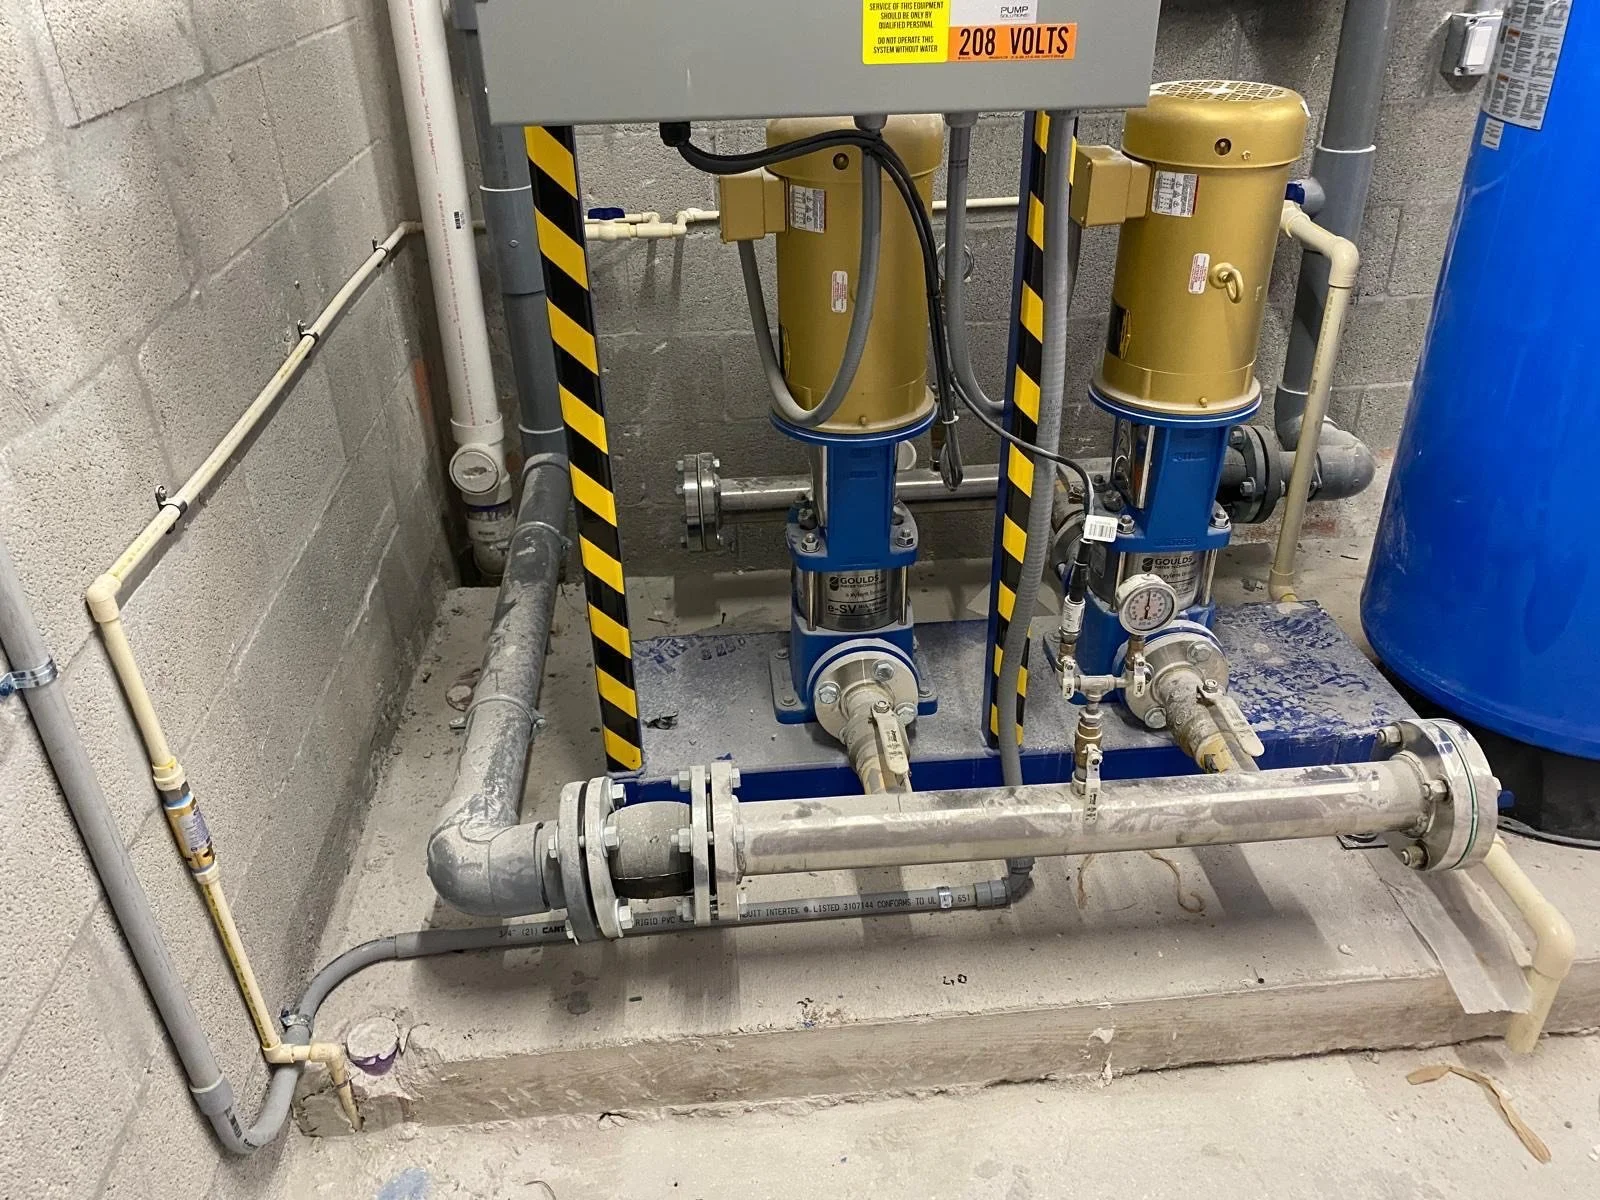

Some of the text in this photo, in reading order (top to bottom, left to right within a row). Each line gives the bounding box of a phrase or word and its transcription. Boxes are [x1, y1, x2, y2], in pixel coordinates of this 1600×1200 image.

[870, 2, 891, 10] SERVICE
[958, 26, 1069, 56] 208 VOLTS
[1154, 555, 1193, 566] GOULDS
[840, 574, 880, 584] GOULDS
[828, 604, 857, 614] e-SV
[636, 917, 658, 926] RIGID
[662, 916, 675, 924] PVC
[766, 907, 800, 916] INTERTEK
[813, 904, 840, 912] LISTED
[844, 900, 873, 910] 3107144
[877, 898, 912, 908] CONFORMS
[916, 897, 924, 905] TO
